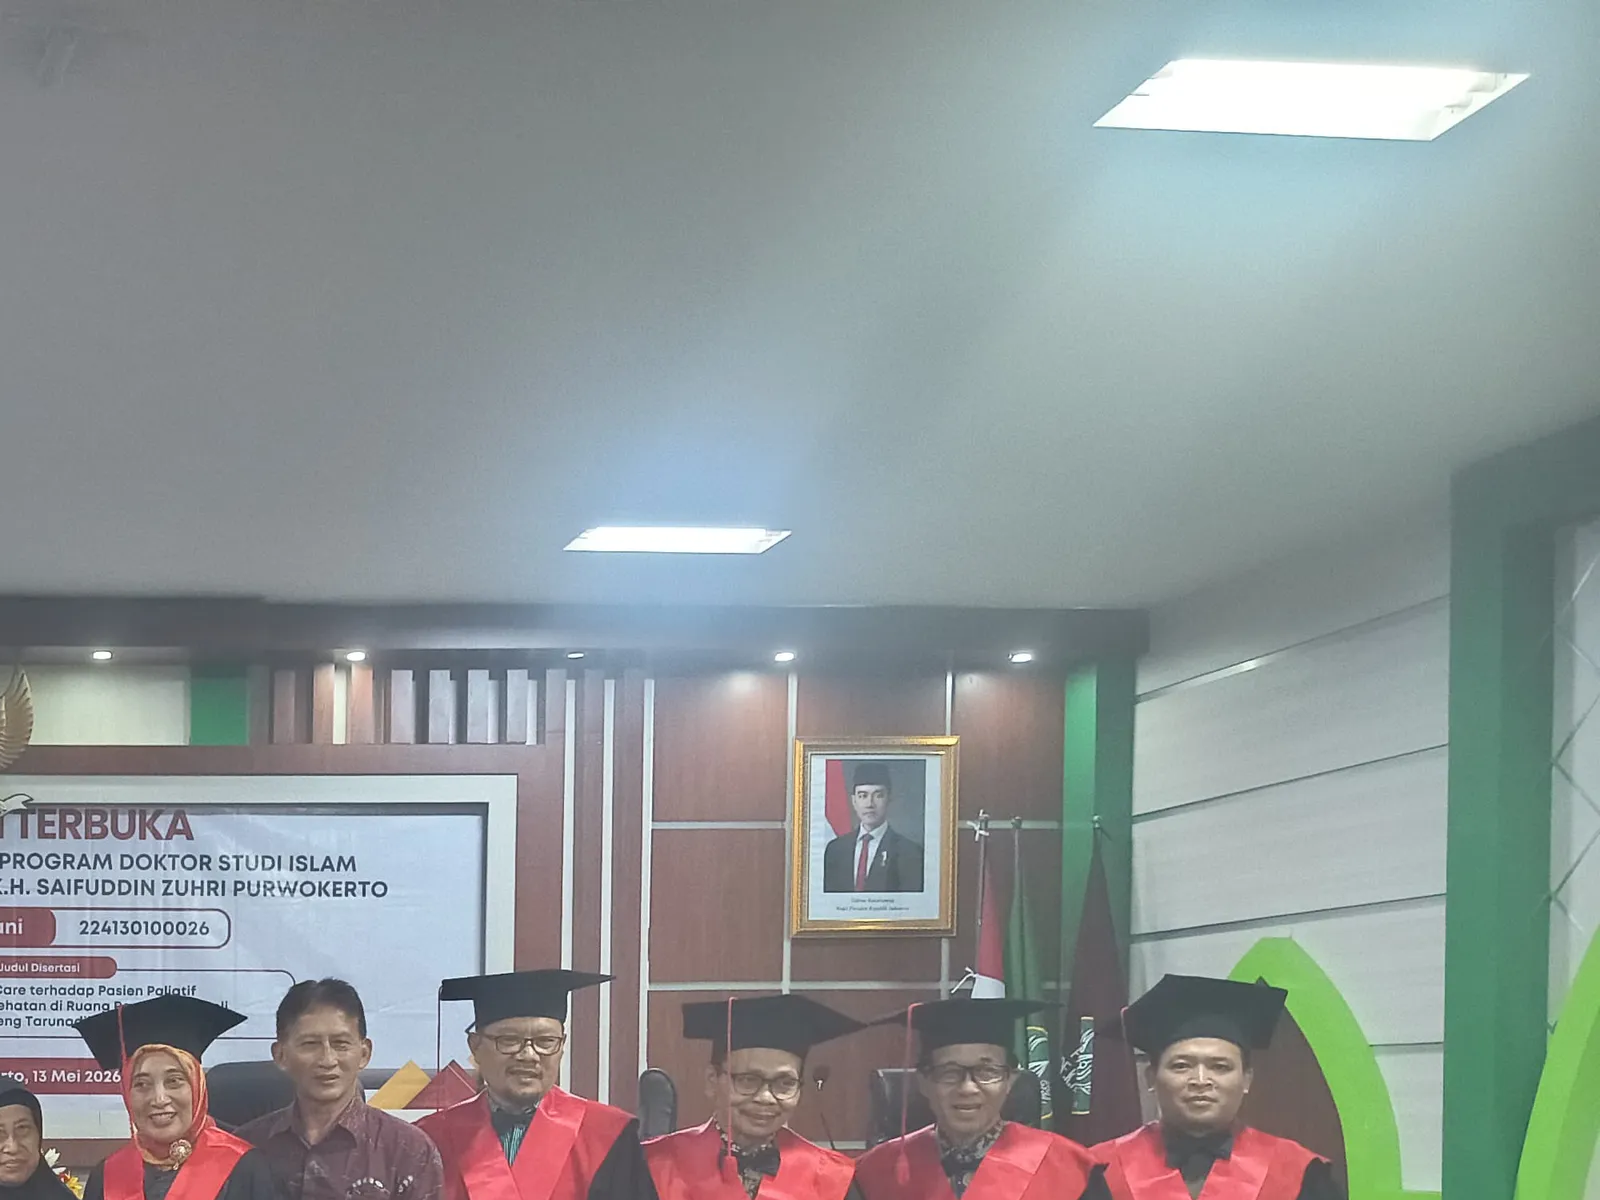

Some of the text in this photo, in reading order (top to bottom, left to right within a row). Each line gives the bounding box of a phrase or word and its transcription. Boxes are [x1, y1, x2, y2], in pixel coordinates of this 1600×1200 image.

[11, 808, 194, 841] TERBUKA
[119, 853, 212, 871] DOKTOR
[218, 854, 282, 872] STUDI
[289, 854, 357, 873] ISLAM
[36, 878, 155, 896] SAIFUDDIN
[161, 879, 226, 897] ZUHRI
[233, 880, 388, 898] PURWOKERTO
[79, 920, 210, 936] 224130100026
[31, 962, 81, 973] Disertasi
[29, 984, 95, 998] terhadap
[98, 985, 143, 997] Pasien
[49, 999, 63, 1012] di
[32, 1070, 47, 1083] 13
[50, 1069, 81, 1083] Mei
[84, 1070, 122, 1083] 2026
